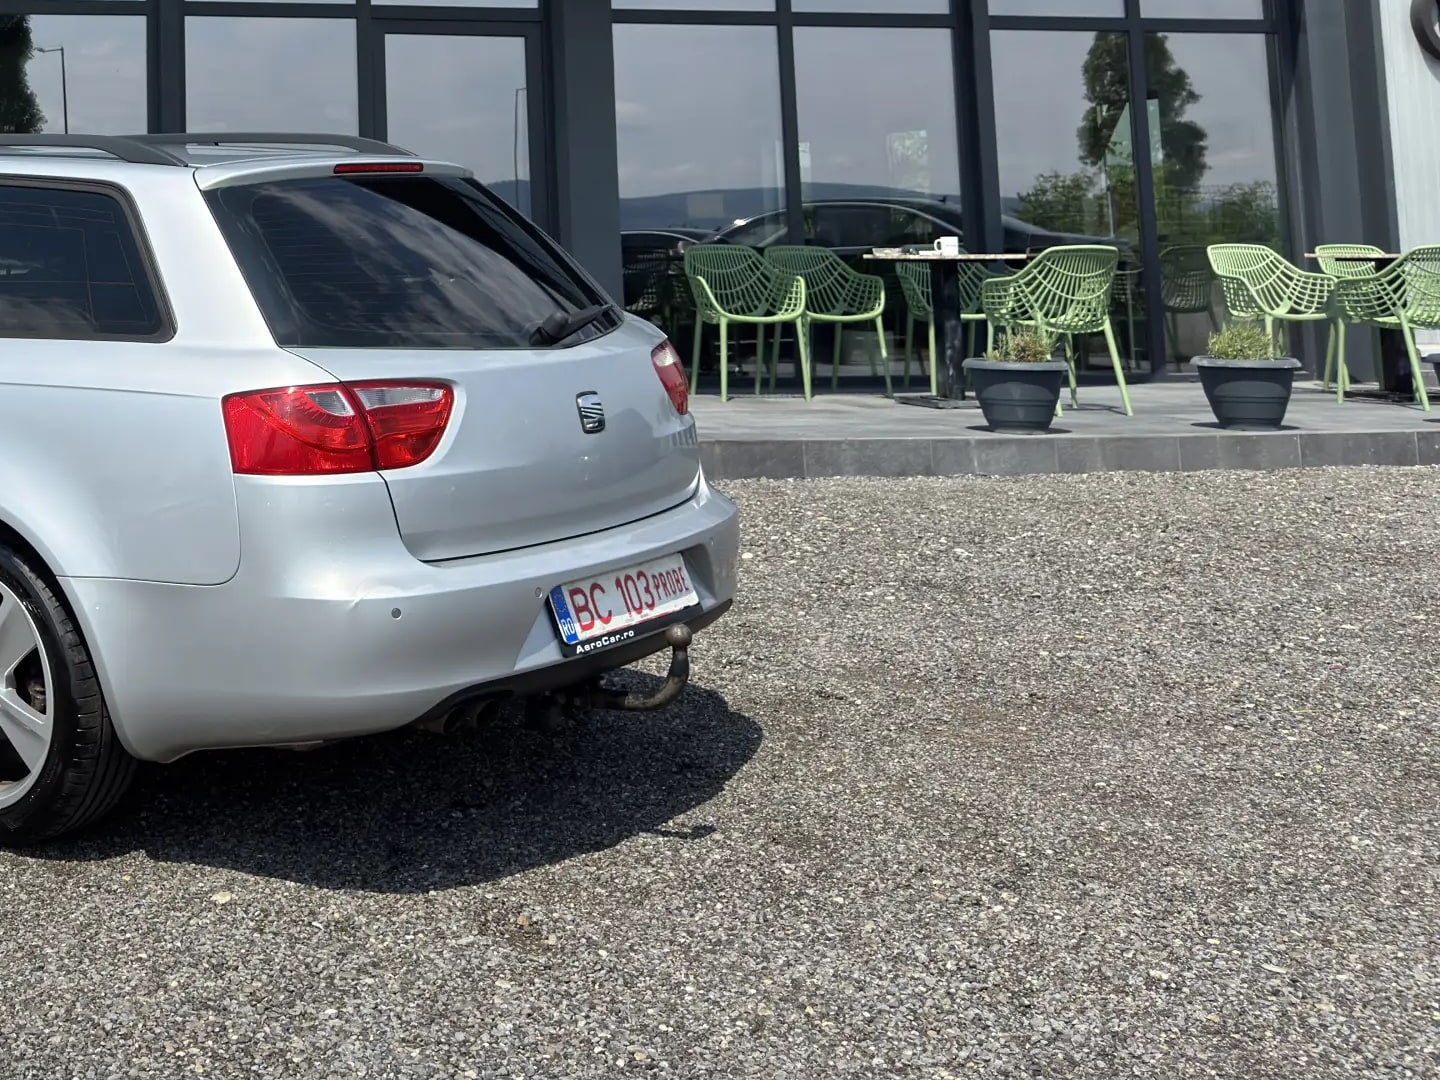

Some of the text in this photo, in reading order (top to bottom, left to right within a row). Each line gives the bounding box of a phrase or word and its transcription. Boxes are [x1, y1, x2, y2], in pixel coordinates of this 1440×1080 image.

[568, 566, 690, 632] BC 103 PROBE
[560, 618, 575, 637] RO
[576, 629, 635, 655] AeroCar.ro
